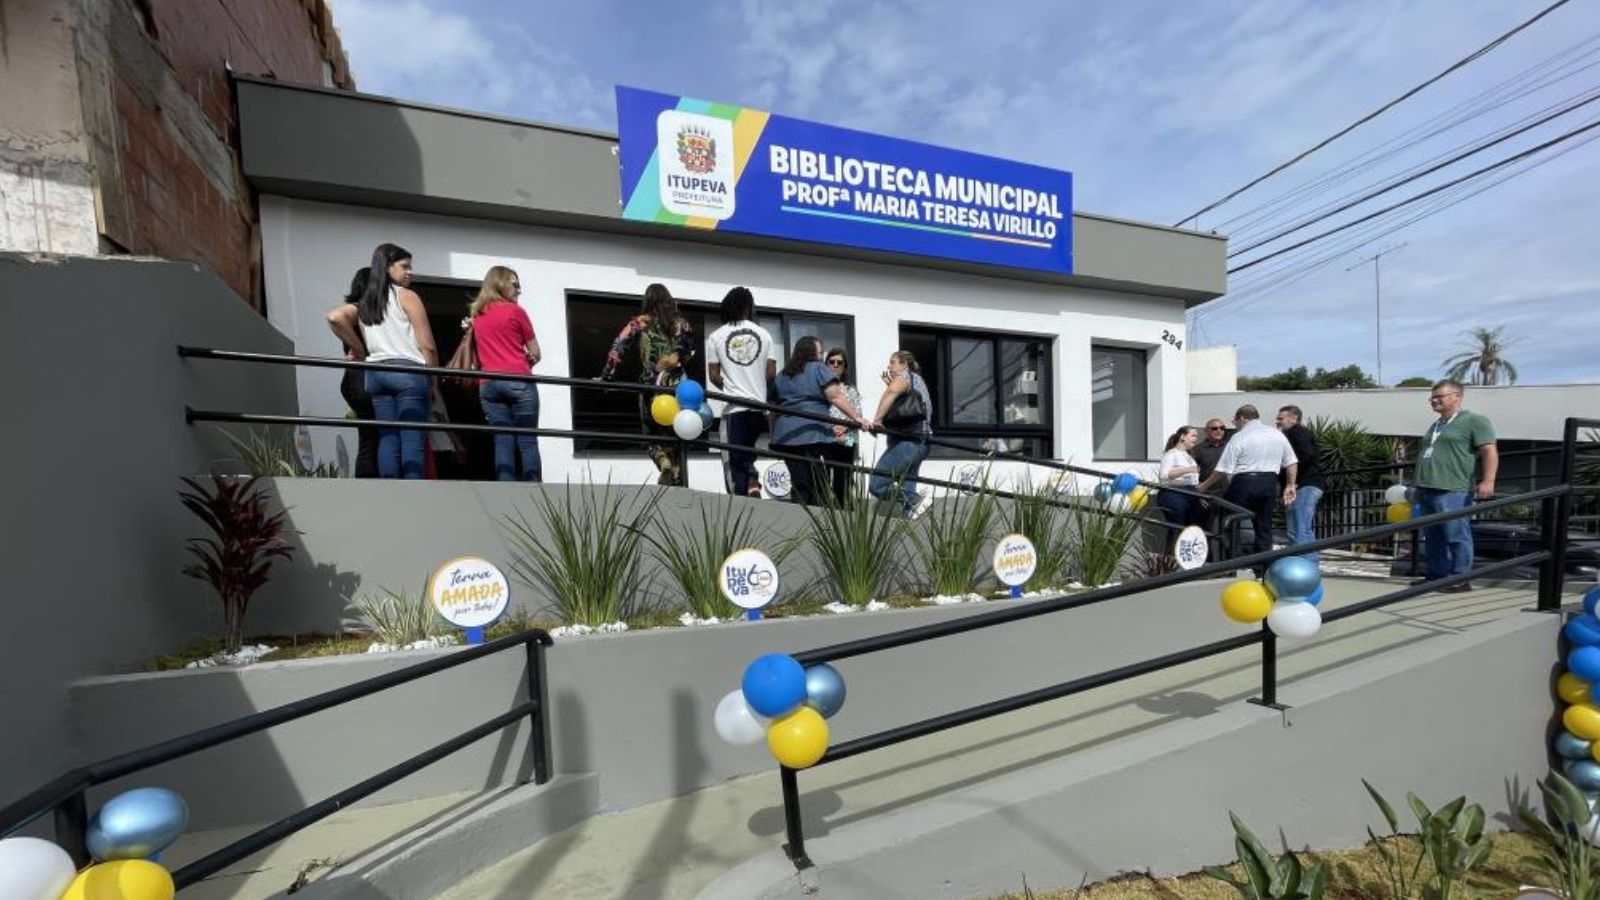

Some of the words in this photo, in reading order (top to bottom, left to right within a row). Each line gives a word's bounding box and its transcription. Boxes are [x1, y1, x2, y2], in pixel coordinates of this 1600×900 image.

[667, 174, 727, 195] ITUPEVA
[769, 144, 931, 198] BIBLIOTECA
[935, 173, 1063, 219] MUNICIPAL
[672, 190, 723, 203] PREFEITURA
[782, 179, 850, 208] PROFª
[855, 192, 919, 220] MARIA
[922, 202, 990, 229] TERESA
[993, 213, 1056, 239] VIRILLO
[1161, 329, 1183, 351] 294
[441, 582, 504, 606] AMADA
